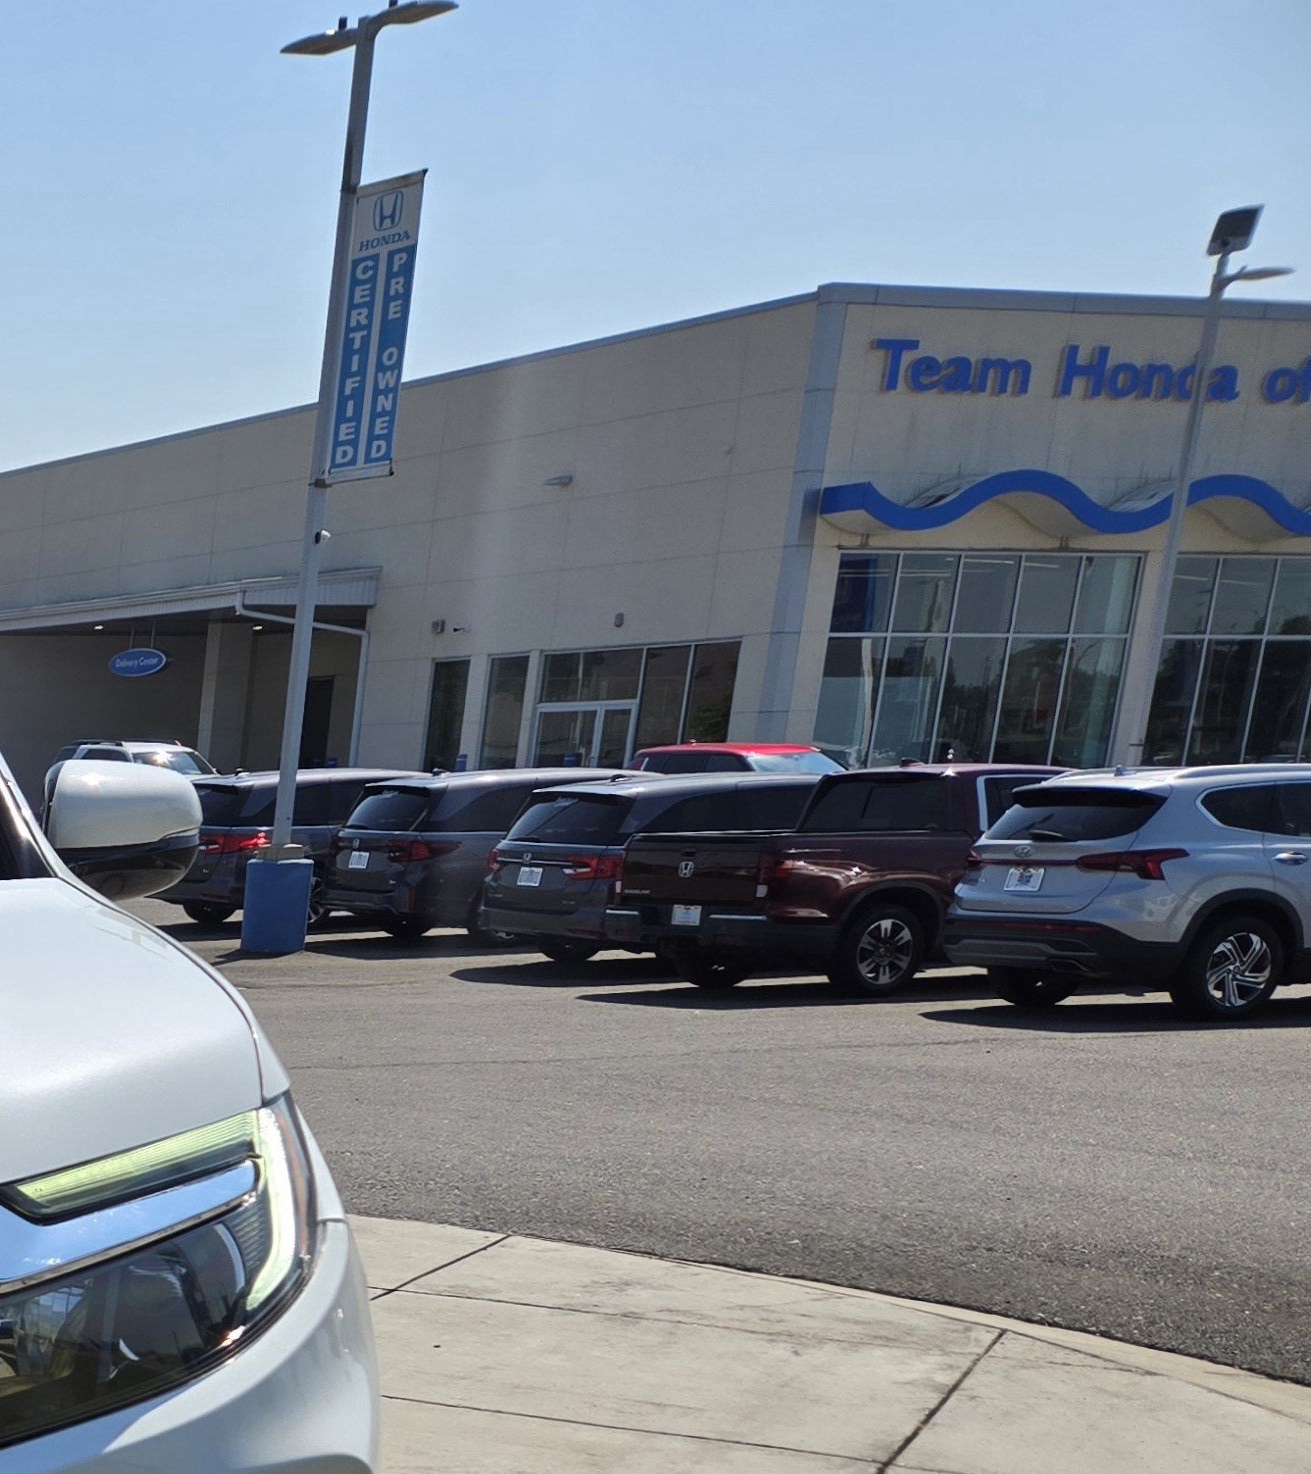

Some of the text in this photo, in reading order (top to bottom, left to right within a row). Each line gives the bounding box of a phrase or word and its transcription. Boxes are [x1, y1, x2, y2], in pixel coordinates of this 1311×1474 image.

[358, 230, 411, 252] HONDA
[334, 259, 375, 465] CERTIFIED
[370, 251, 407, 460] PRE OWNED
[875, 338, 1033, 395] Team
